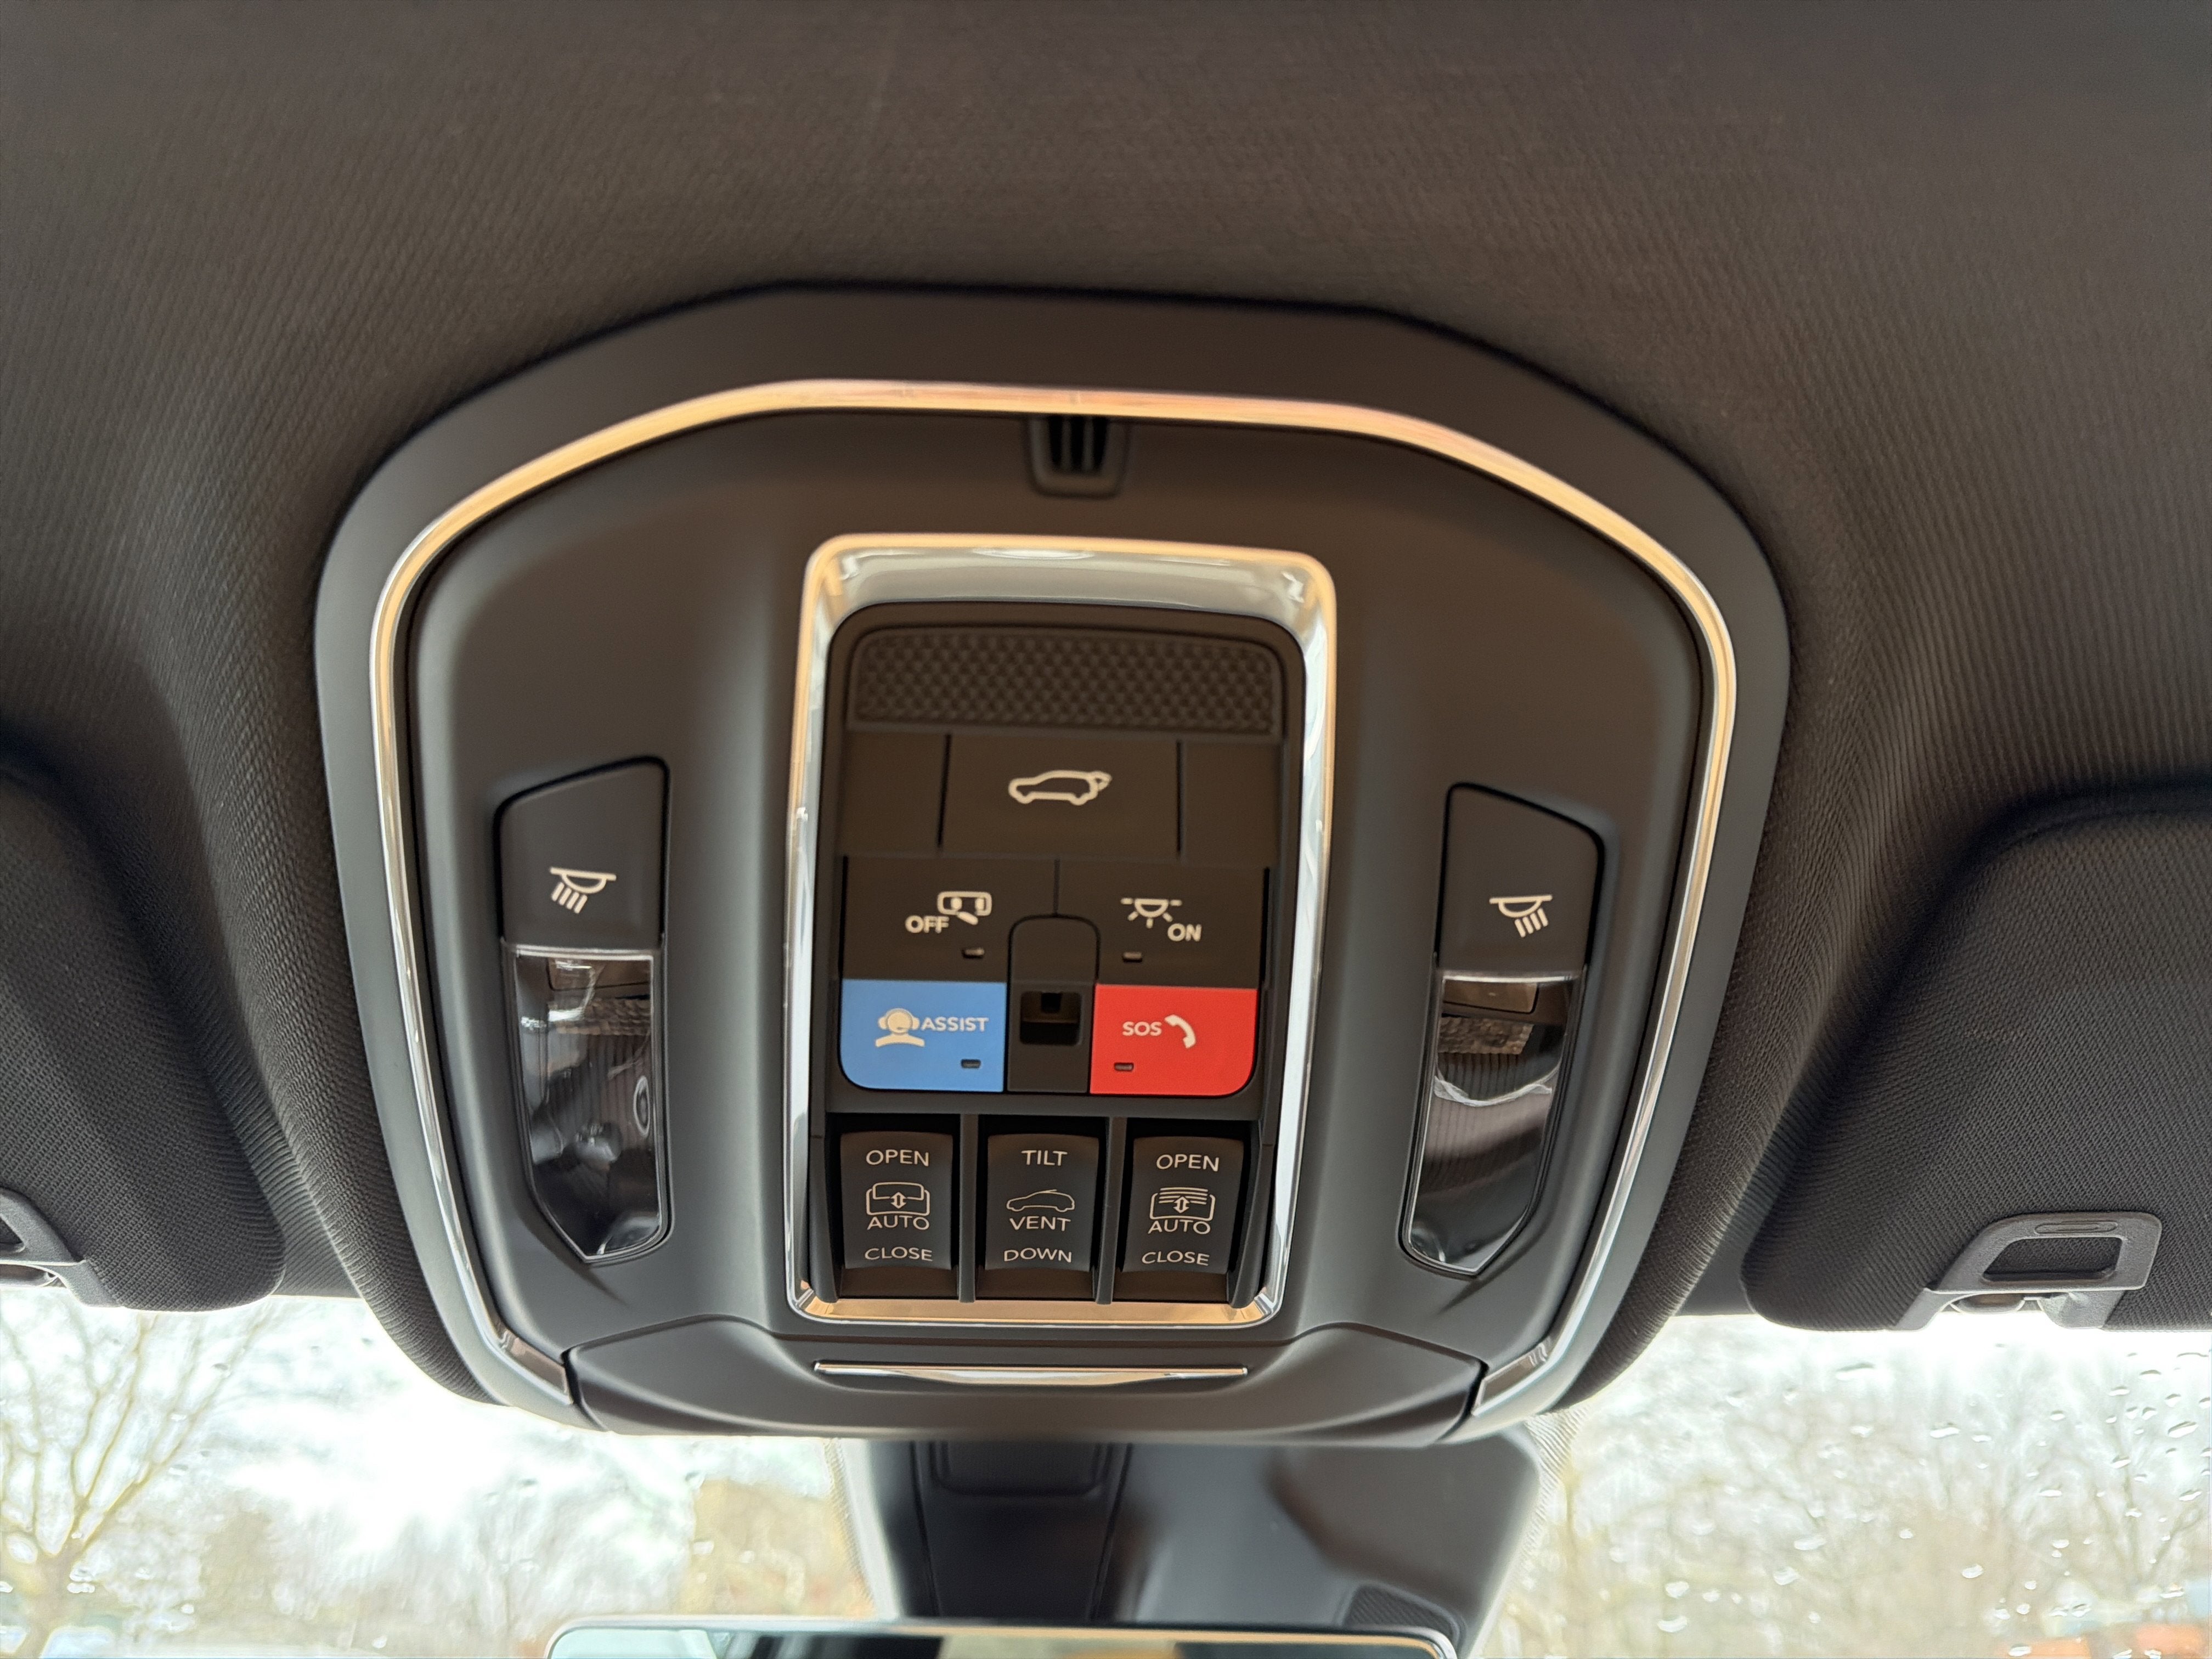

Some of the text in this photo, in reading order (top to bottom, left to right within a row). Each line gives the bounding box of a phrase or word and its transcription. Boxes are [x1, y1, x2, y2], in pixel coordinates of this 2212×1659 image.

[905, 915, 949, 934] OFF
[1167, 923, 1201, 943] ON
[921, 1017, 989, 1032] ASSIST
[1122, 1020, 1162, 1036] SOS
[866, 1149, 930, 1167] OPEN
[1021, 1149, 1068, 1166] TILT
[1156, 1154, 1220, 1172] OPEN
[867, 1215, 930, 1231] AUTO
[1009, 1216, 1071, 1232] VENT
[1147, 1218, 1211, 1235] AUTO
[864, 1247, 933, 1262] CLOSE
[1003, 1248, 1073, 1263] DOWN
[1141, 1250, 1210, 1266] CLOSE
